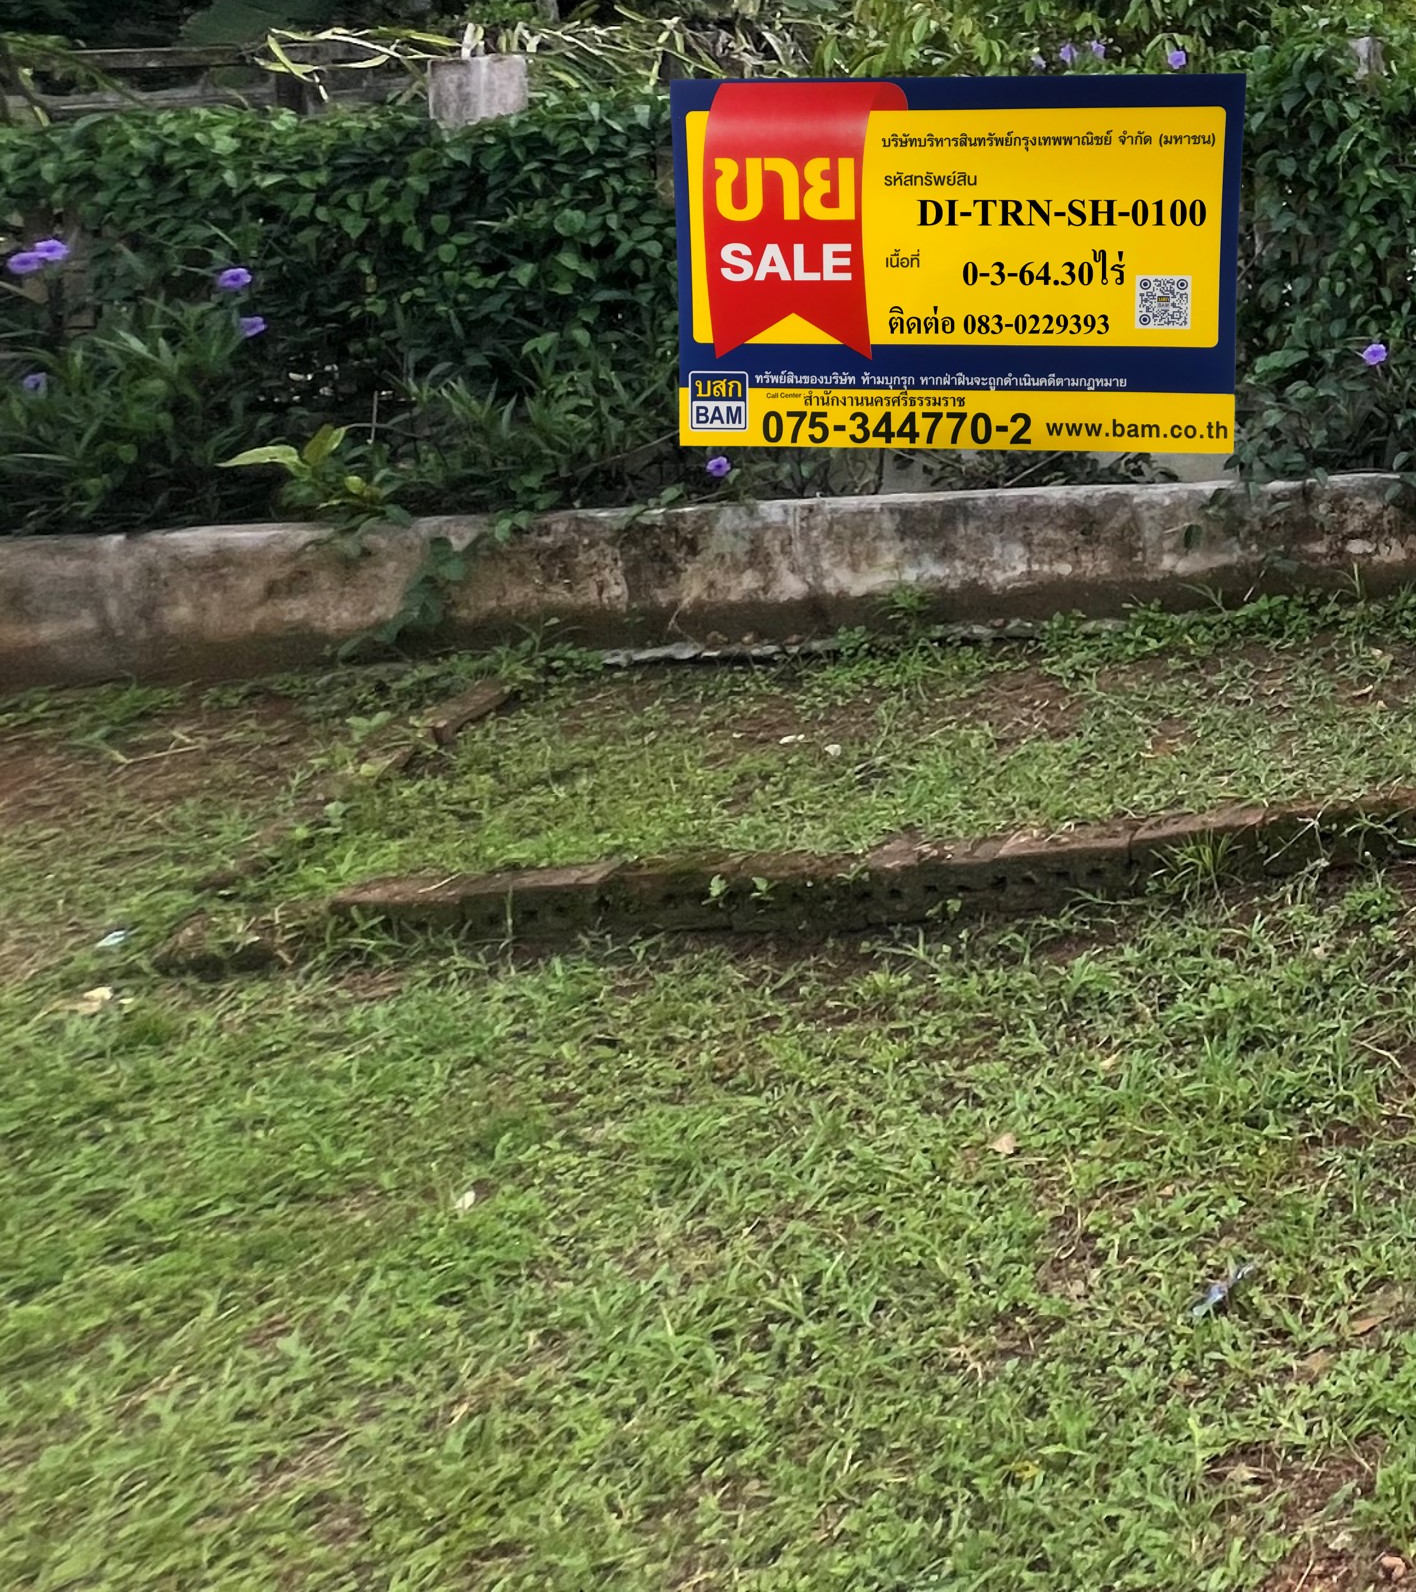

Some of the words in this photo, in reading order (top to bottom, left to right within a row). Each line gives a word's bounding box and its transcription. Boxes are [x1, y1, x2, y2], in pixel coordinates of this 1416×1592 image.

[881, 130, 1113, 151] บริษัทบริหารสินทรัพย์กรุงเทพพาณิชย์
[1118, 132, 1153, 146] จำกัด
[1158, 133, 1216, 148] (มหาชน)
[714, 157, 855, 221] ขาย
[884, 171, 978, 187] รหัสทรัพย์สิน
[916, 198, 1207, 227] DI-TRN-SH-0100
[720, 242, 852, 282] SALE
[885, 249, 921, 268] เนื้อที่
[888, 306, 955, 334] ติดต่อ
[963, 314, 1110, 335] 083-0229393
[695, 379, 742, 398] บสก
[754, 371, 856, 386] ทรัพย์สินของบริษัท
[861, 374, 915, 389] ห้ามบุกรุก
[919, 373, 1127, 390] หากฝ่าฝืนจะถูกดำเนินคดีตามกฎหมาย
[803, 390, 966, 408] สำนักงานนครศรีธรรมราช
[695, 406, 742, 425] BAM
[762, 411, 1032, 445] 075-344770-2
[1046, 419, 1228, 439] www.bam.co.th
